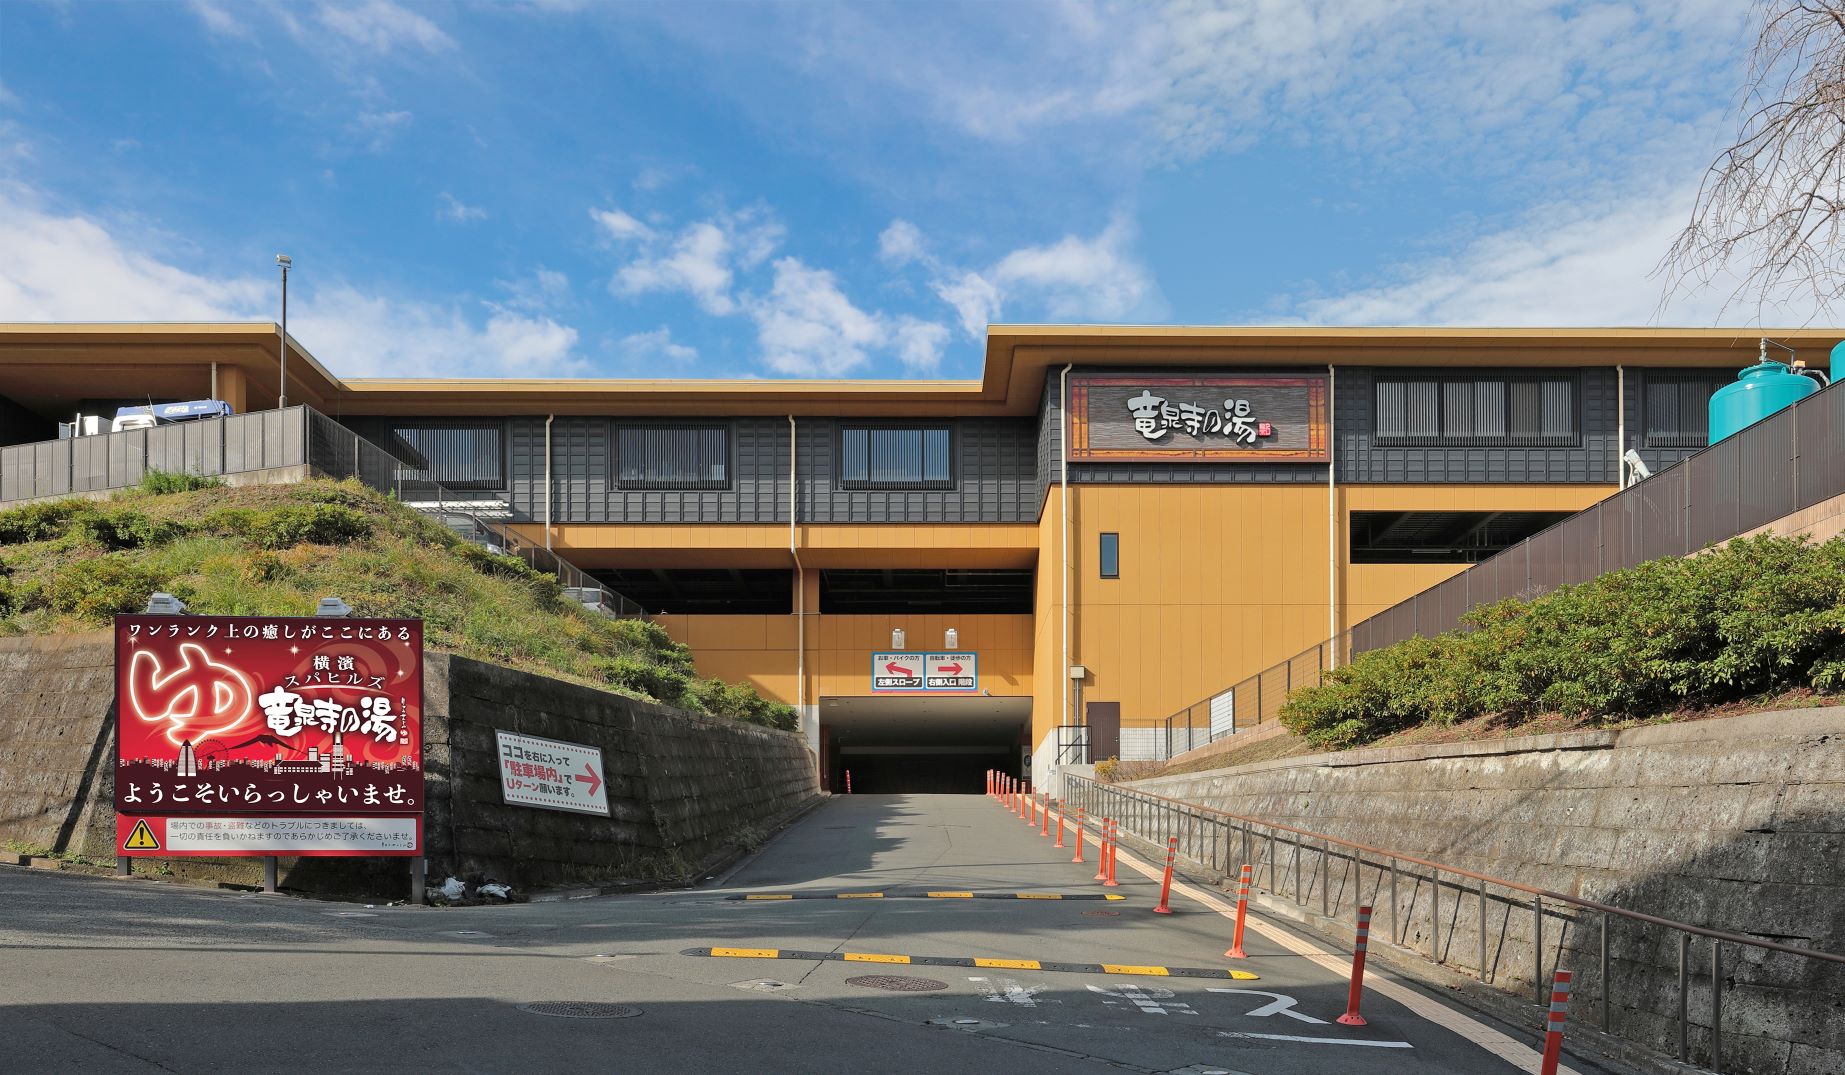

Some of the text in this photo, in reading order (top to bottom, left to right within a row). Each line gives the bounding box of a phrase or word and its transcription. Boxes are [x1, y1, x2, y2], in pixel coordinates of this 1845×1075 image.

[1127, 390, 1256, 443] 竜泉寺の湯
[129, 624, 411, 640] ワンランク上の癒しがここにある
[313, 655, 355, 671] 横濱
[284, 672, 386, 689] スパヒルズ
[878, 678, 920, 686] 左側スロープ
[258, 685, 398, 743] 竜泉寺の湯
[502, 744, 570, 766] ココを右に入って
[123, 782, 415, 805] ようこそいらっしゃいませ。
